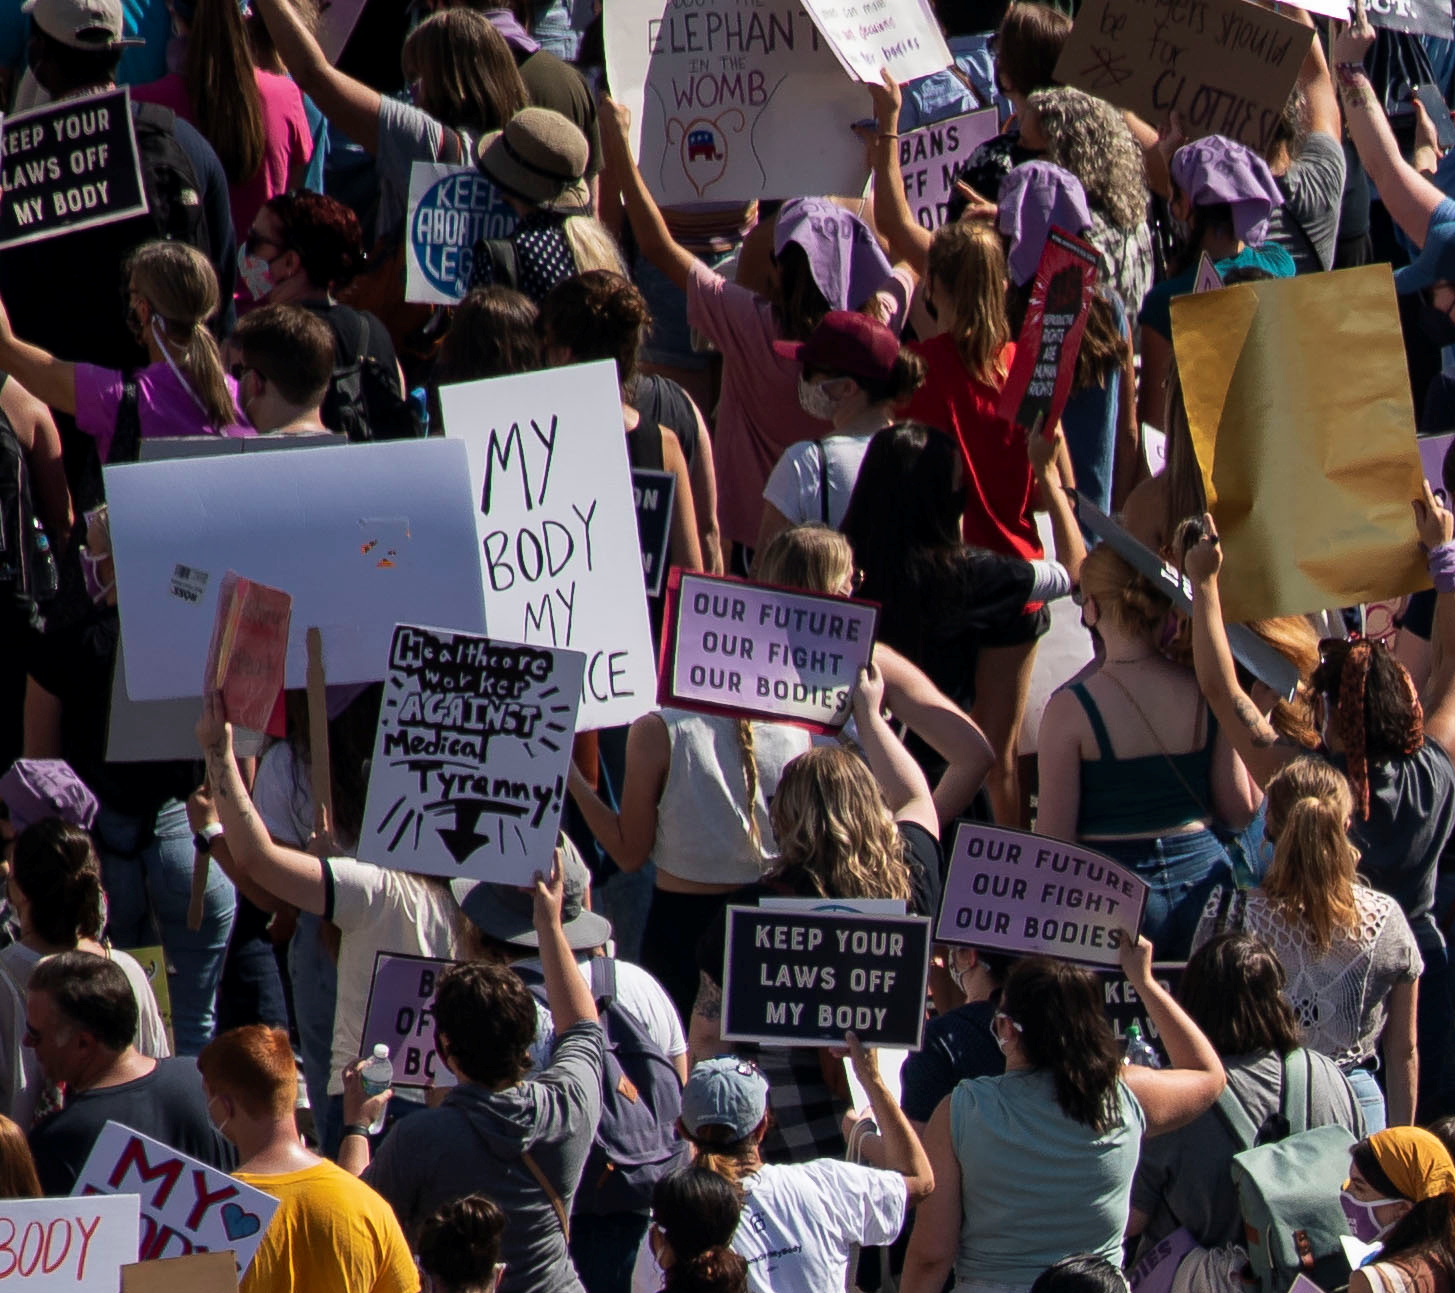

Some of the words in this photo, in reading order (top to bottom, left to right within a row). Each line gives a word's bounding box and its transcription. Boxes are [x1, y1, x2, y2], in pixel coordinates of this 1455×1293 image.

[397, 631, 549, 676] Healthcare
[425, 670, 529, 696] worker
[400, 695, 542, 736] AGAINST
[383, 729, 488, 766] Medical
[416, 766, 564, 828] Tyranny!
